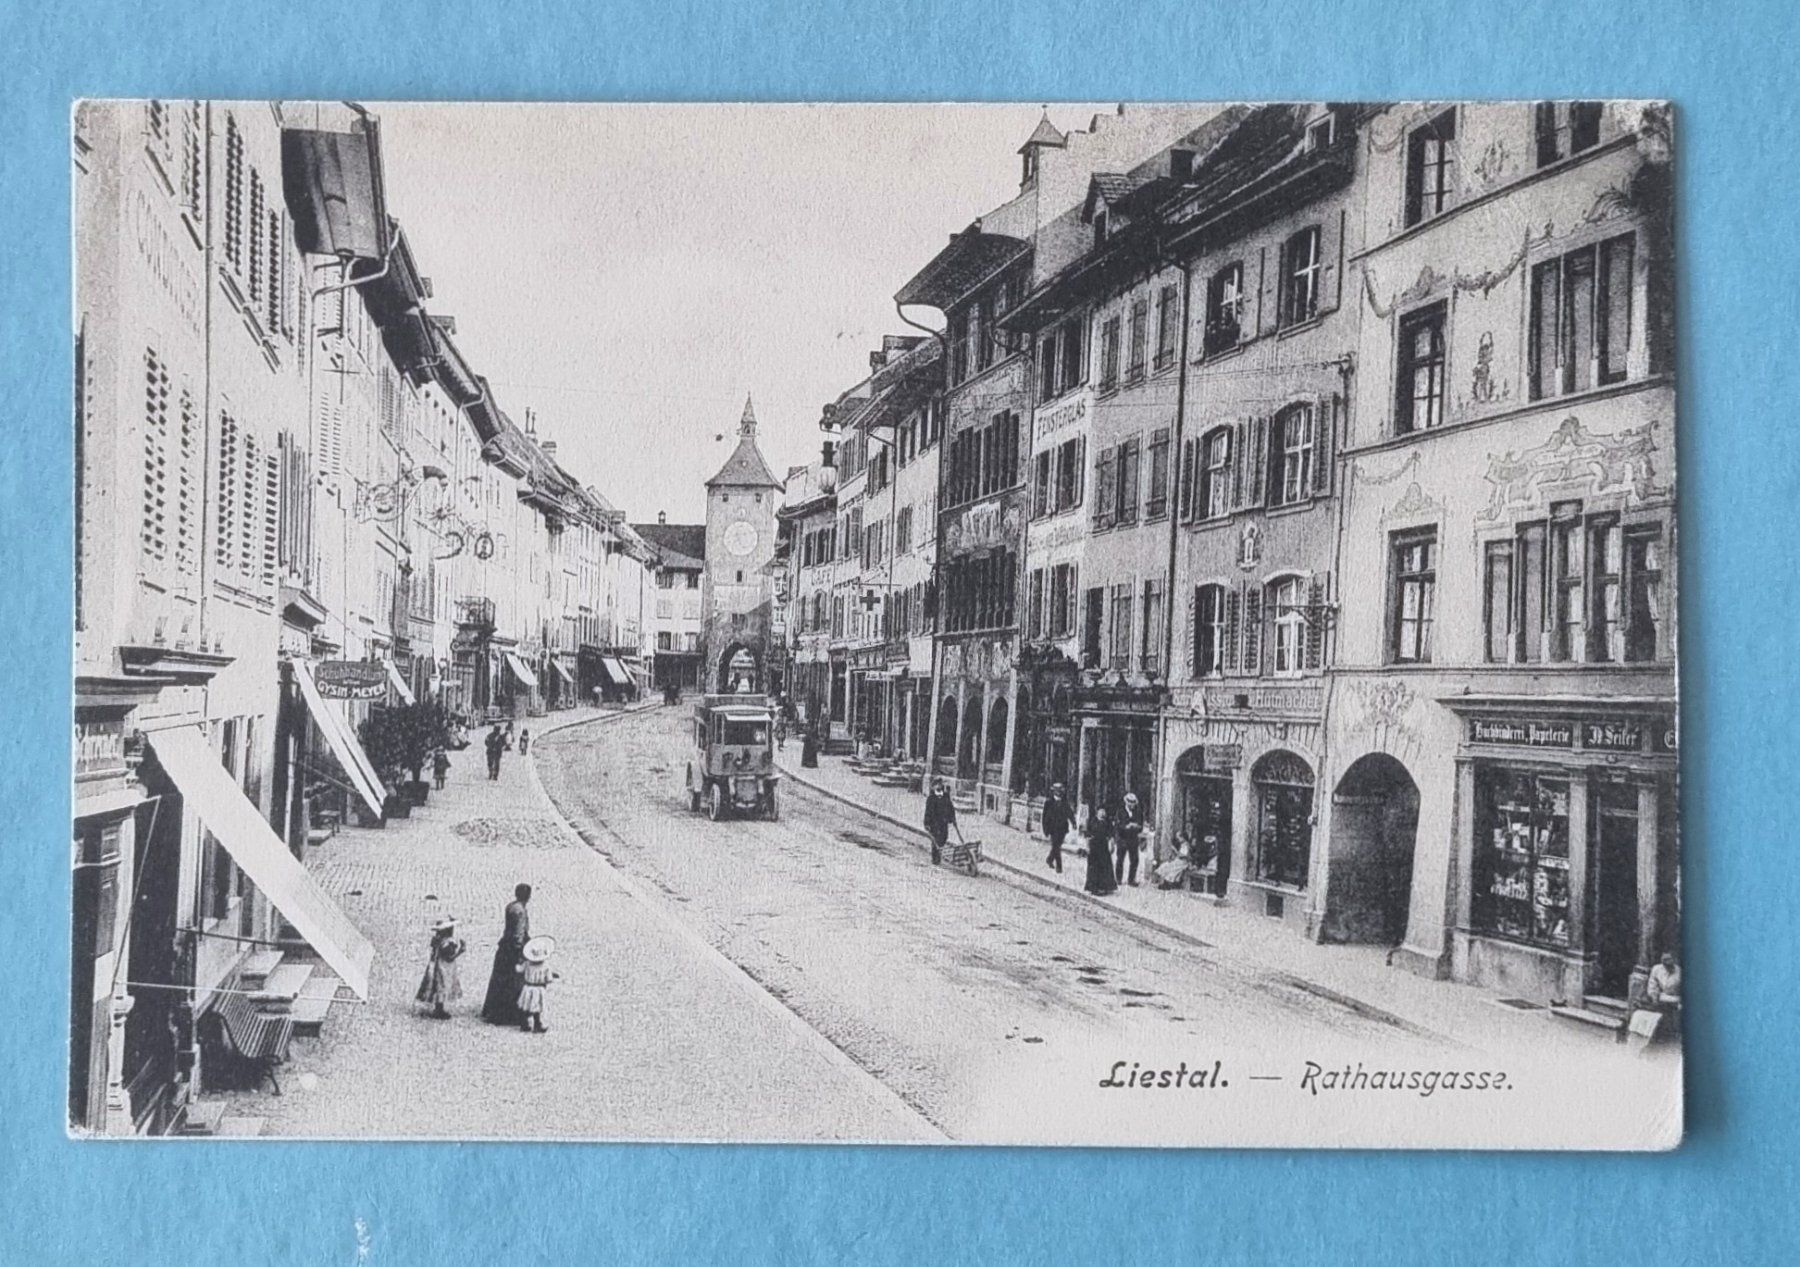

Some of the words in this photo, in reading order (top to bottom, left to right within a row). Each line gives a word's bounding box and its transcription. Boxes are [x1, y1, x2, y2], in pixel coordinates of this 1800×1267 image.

[1255, 688, 1319, 709] Hutmacher
[1098, 1060, 1229, 1089] Liestal.
[1300, 1060, 1514, 1097] Rathausgasse.
